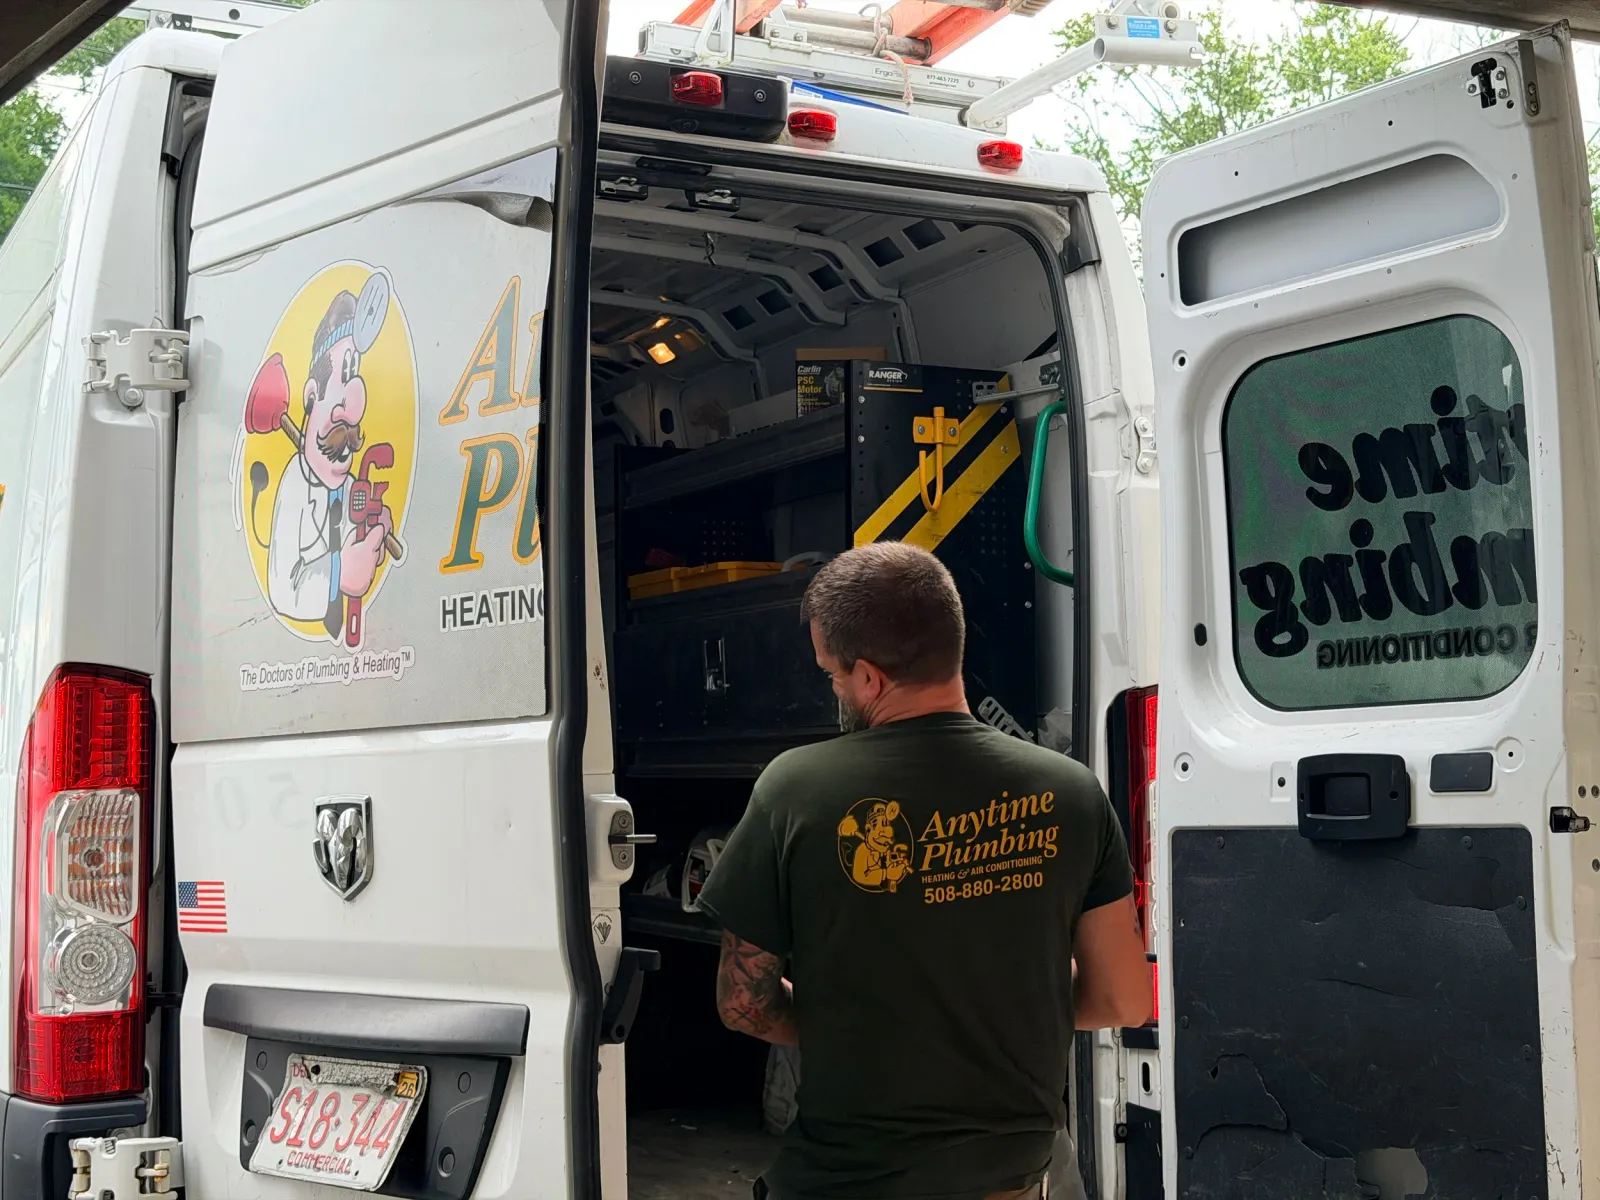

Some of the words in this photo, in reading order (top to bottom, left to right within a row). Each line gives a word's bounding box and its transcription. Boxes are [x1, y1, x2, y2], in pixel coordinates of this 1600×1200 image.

[797, 365, 821, 374] Carlin
[797, 376, 814, 384] PSC
[868, 370, 902, 380] RANGER
[797, 385, 822, 393] Motor
[241, 669, 257, 686] The
[259, 667, 294, 684] Doctors
[295, 666, 306, 680] of
[307, 659, 350, 681] Plumbing
[353, 657, 360, 674] &
[917, 790, 1055, 843] Anytime
[919, 823, 1059, 872] Plumbing
[921, 871, 955, 884] HEATING
[957, 869, 970, 879] &
[971, 865, 984, 876] AIR
[985, 855, 1043, 873] CONDITIONING
[924, 871, 1043, 904] 508-880-2800
[286, 1151, 352, 1175] COMMERCIAL
